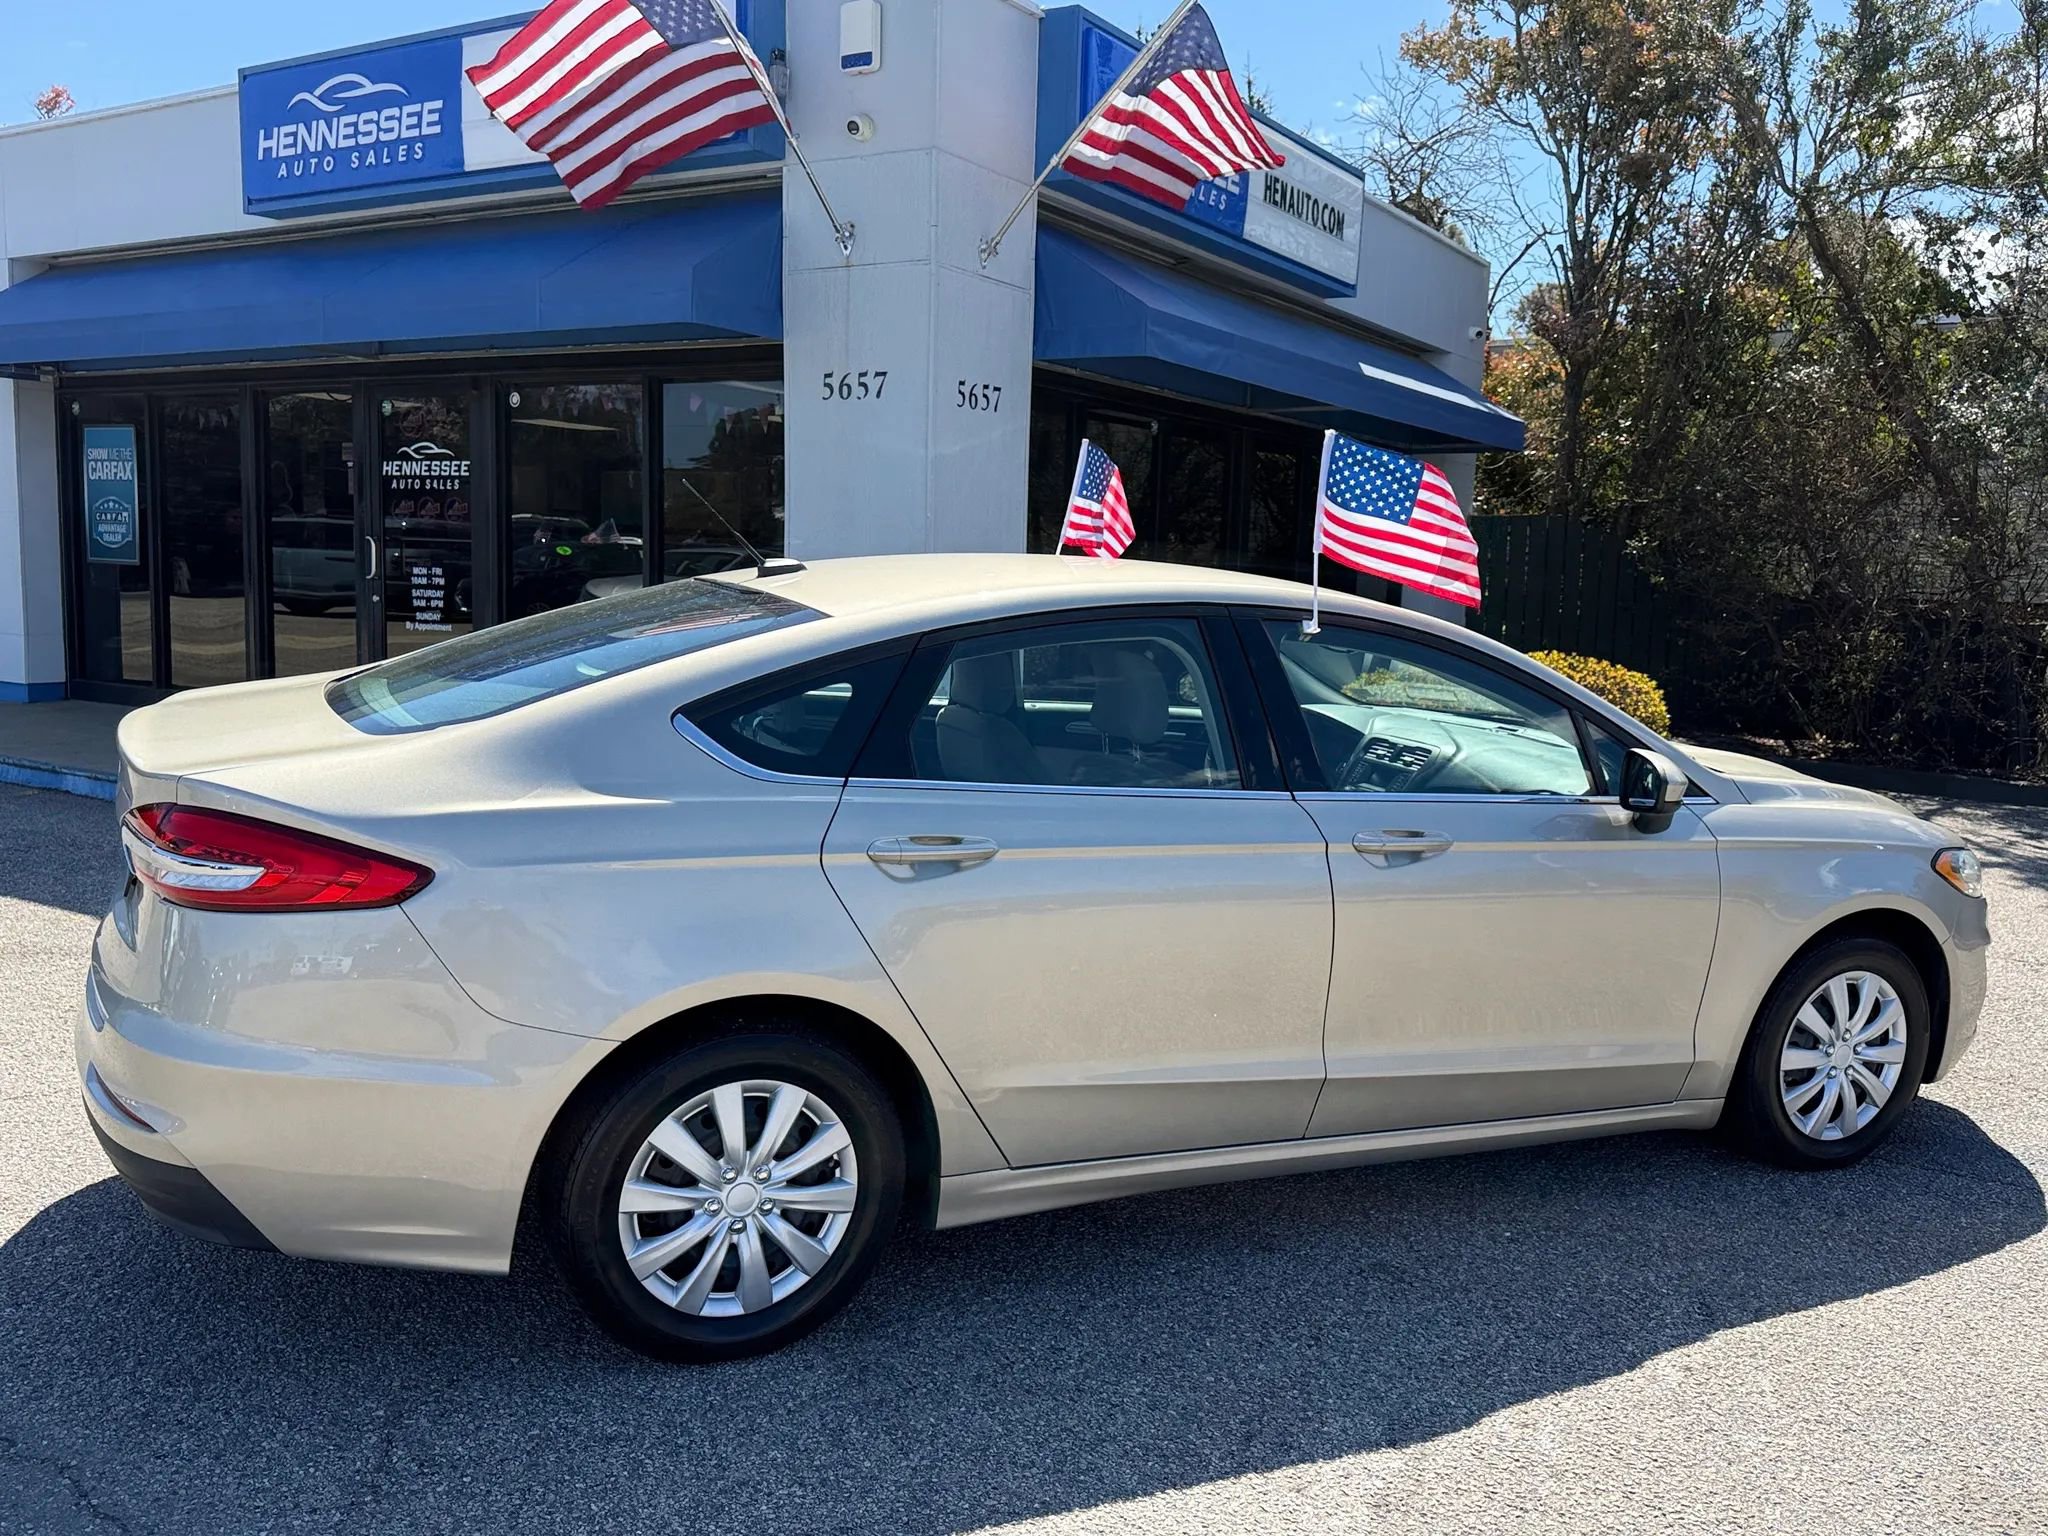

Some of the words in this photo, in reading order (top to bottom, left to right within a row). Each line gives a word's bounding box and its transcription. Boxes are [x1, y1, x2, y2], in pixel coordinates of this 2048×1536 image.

[258, 99, 444, 160] HENNESSEE
[277, 155, 335, 178] AUTO
[350, 142, 424, 169] SALES
[821, 370, 888, 401] 5657
[956, 379, 1002, 413] 5657
[87, 447, 108, 460] SHOW
[109, 447, 119, 460] ME
[119, 447, 133, 460] THE
[88, 461, 133, 480] CARFAX
[382, 460, 471, 476] HENNESSEE
[391, 479, 421, 489] AUTO
[425, 478, 461, 490] SALES
[98, 523, 127, 533] ADVANTAGE
[103, 533, 122, 542] DEALER
[412, 566, 428, 575] MON
[431, 567, 443, 576] FRI
[411, 576, 428, 585] 10AM
[431, 577, 445, 586] 7PM
[411, 588, 445, 598] SATURDAY
[415, 611, 441, 621] SUNDAY
[405, 621, 414, 631] By
[415, 621, 452, 632] Appointment
